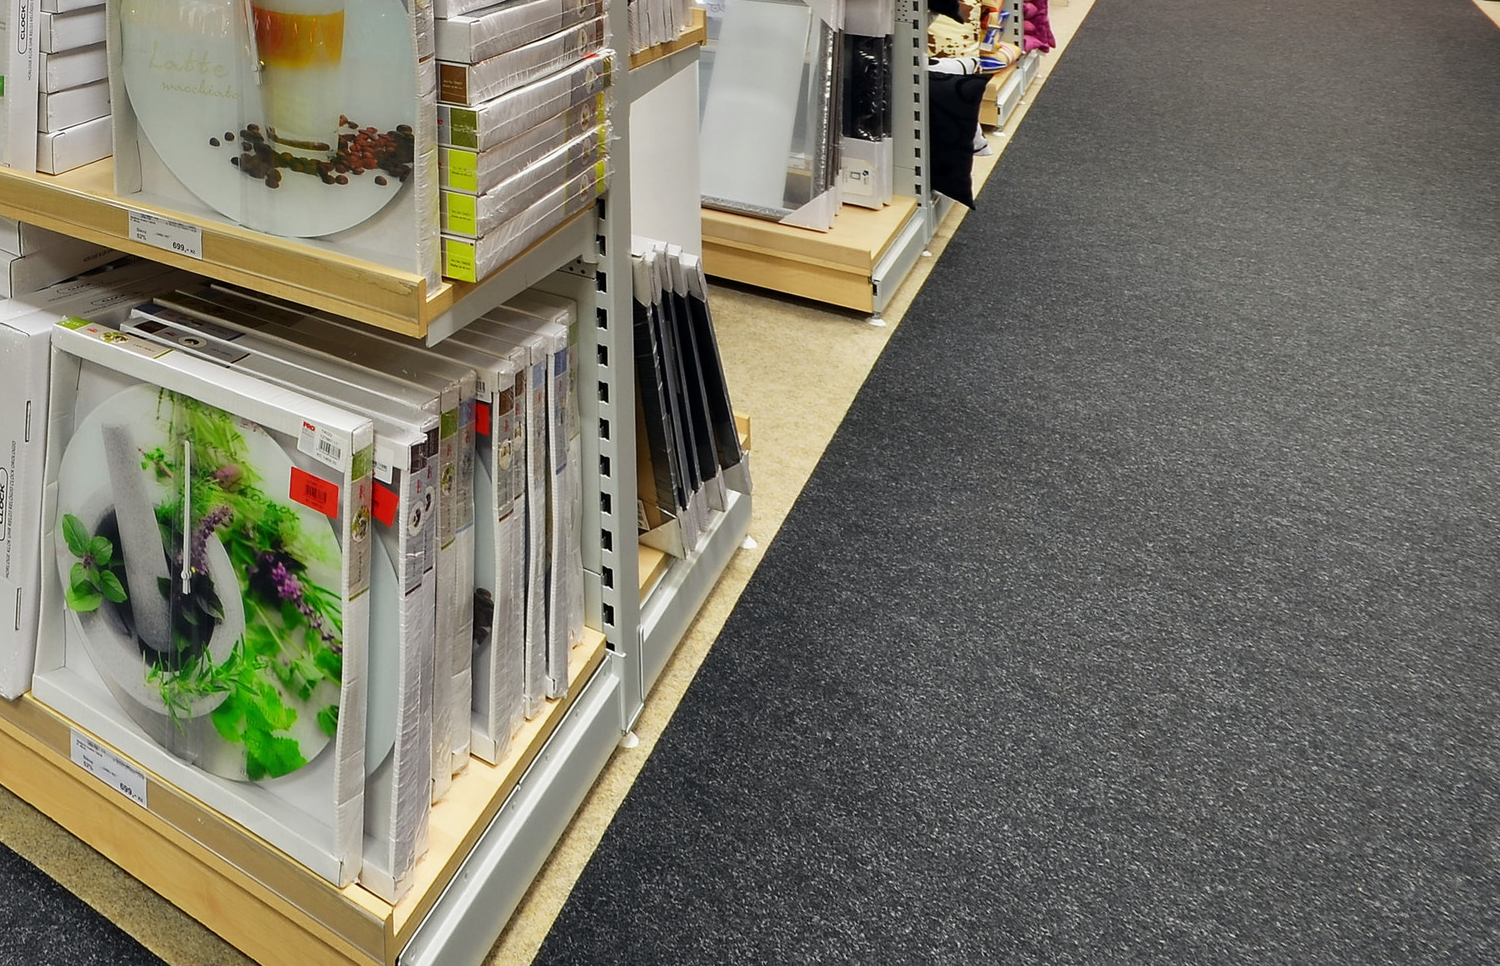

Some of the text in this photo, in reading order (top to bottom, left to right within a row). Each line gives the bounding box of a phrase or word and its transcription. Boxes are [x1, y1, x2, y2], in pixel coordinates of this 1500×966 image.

[148, 40, 230, 78] Latte
[161, 79, 239, 99] macchiato
[172, 241, 190, 253] 699,-
[303, 421, 316, 432] PRO
